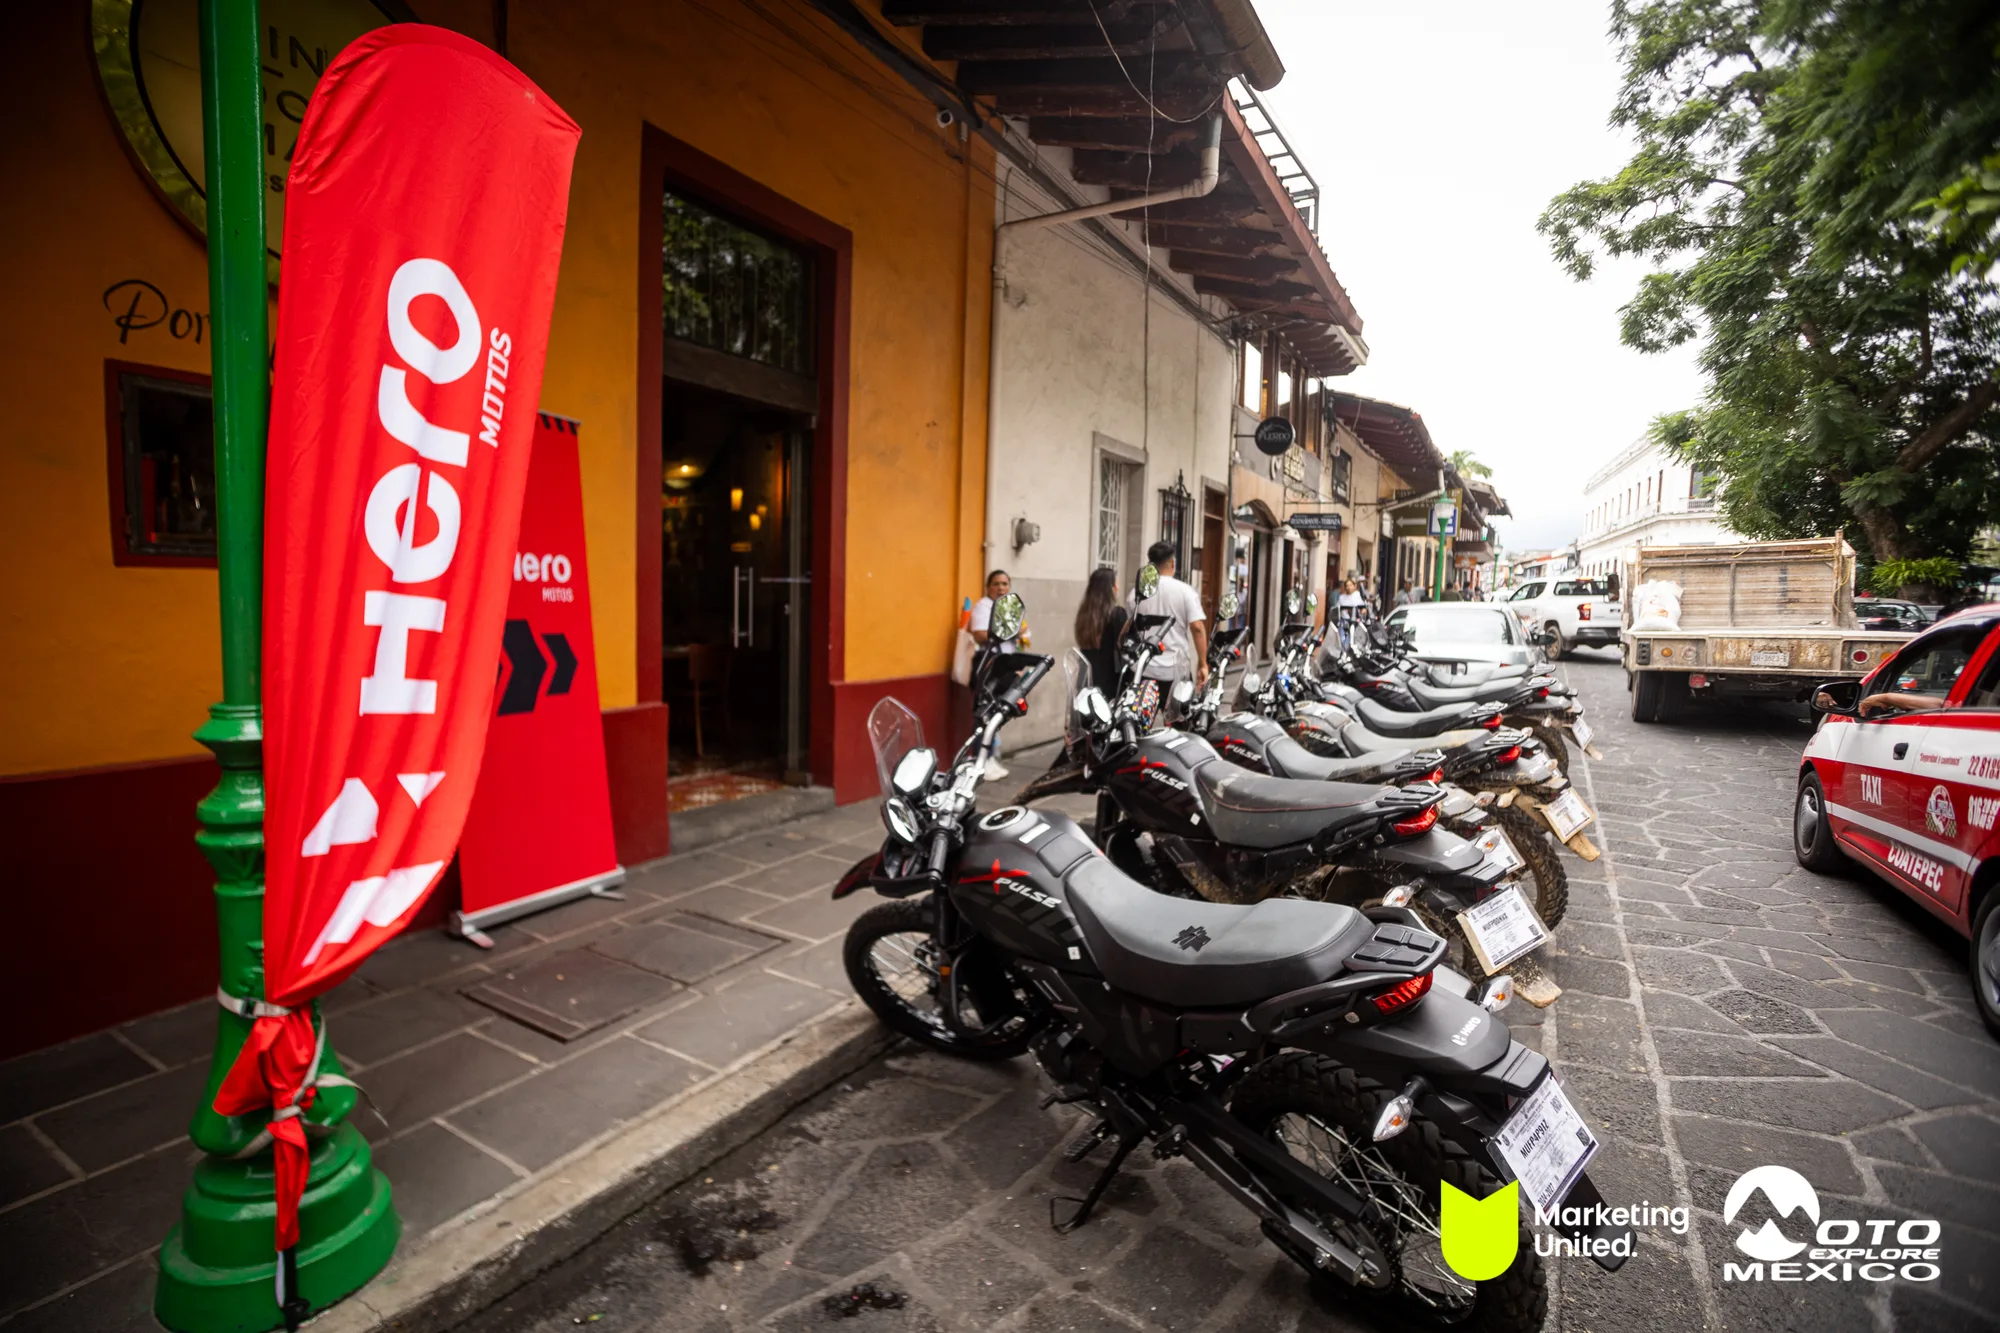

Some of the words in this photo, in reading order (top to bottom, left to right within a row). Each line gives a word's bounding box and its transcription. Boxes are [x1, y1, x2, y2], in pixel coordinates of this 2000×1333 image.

[479, 327, 512, 447] MOTOS
[542, 587, 575, 603] MOTOS
[1860, 773, 1882, 805] TAXI
